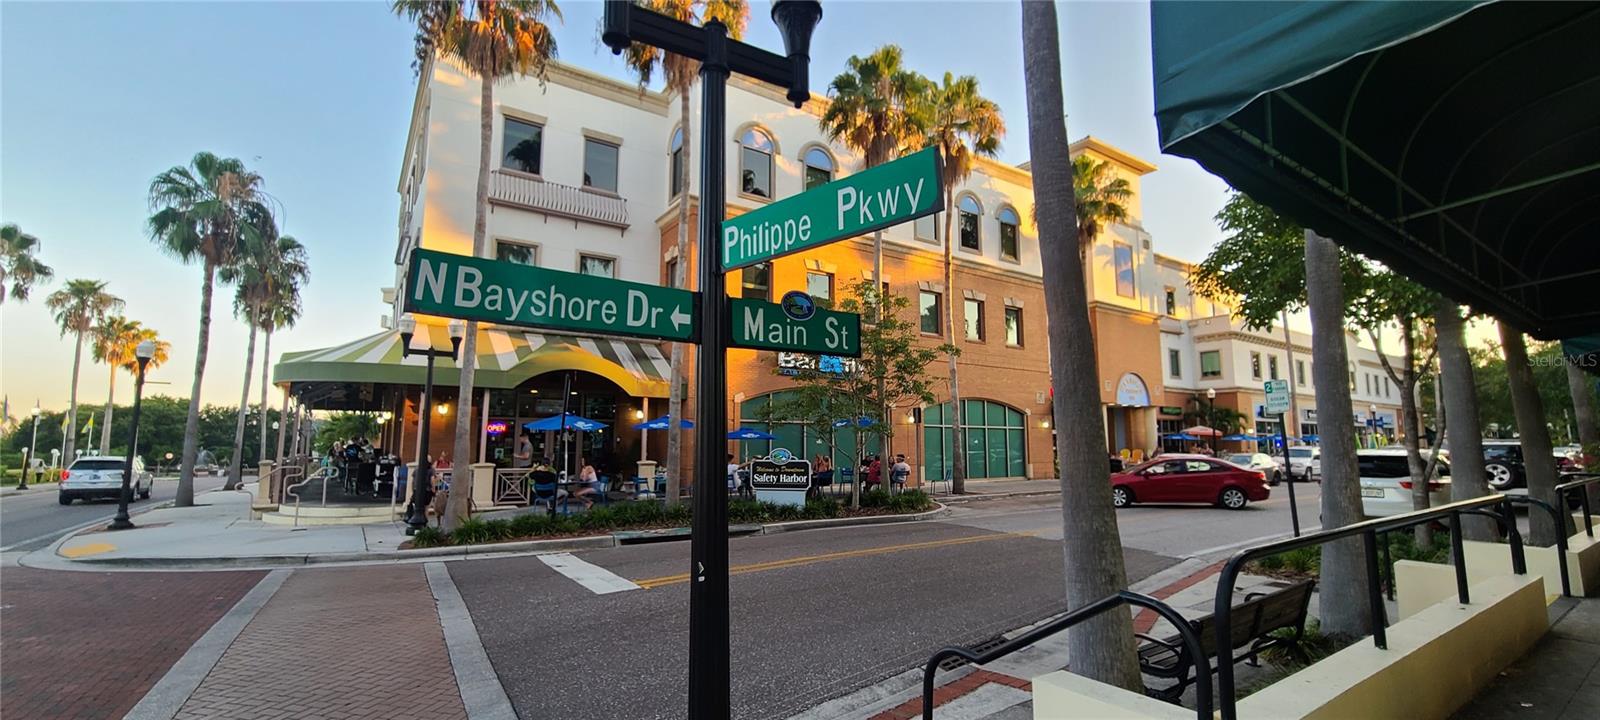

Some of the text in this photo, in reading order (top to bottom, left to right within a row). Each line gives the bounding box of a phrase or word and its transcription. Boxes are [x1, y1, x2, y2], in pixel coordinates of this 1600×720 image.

[723, 177, 924, 264] Philippe Pkwy
[414, 258, 663, 329] N Bayshore Dr
[744, 306, 849, 350] Main St
[1265, 383, 1272, 392] 2
[487, 424, 506, 432] OPEN
[753, 473, 807, 484] Safety Harbor
